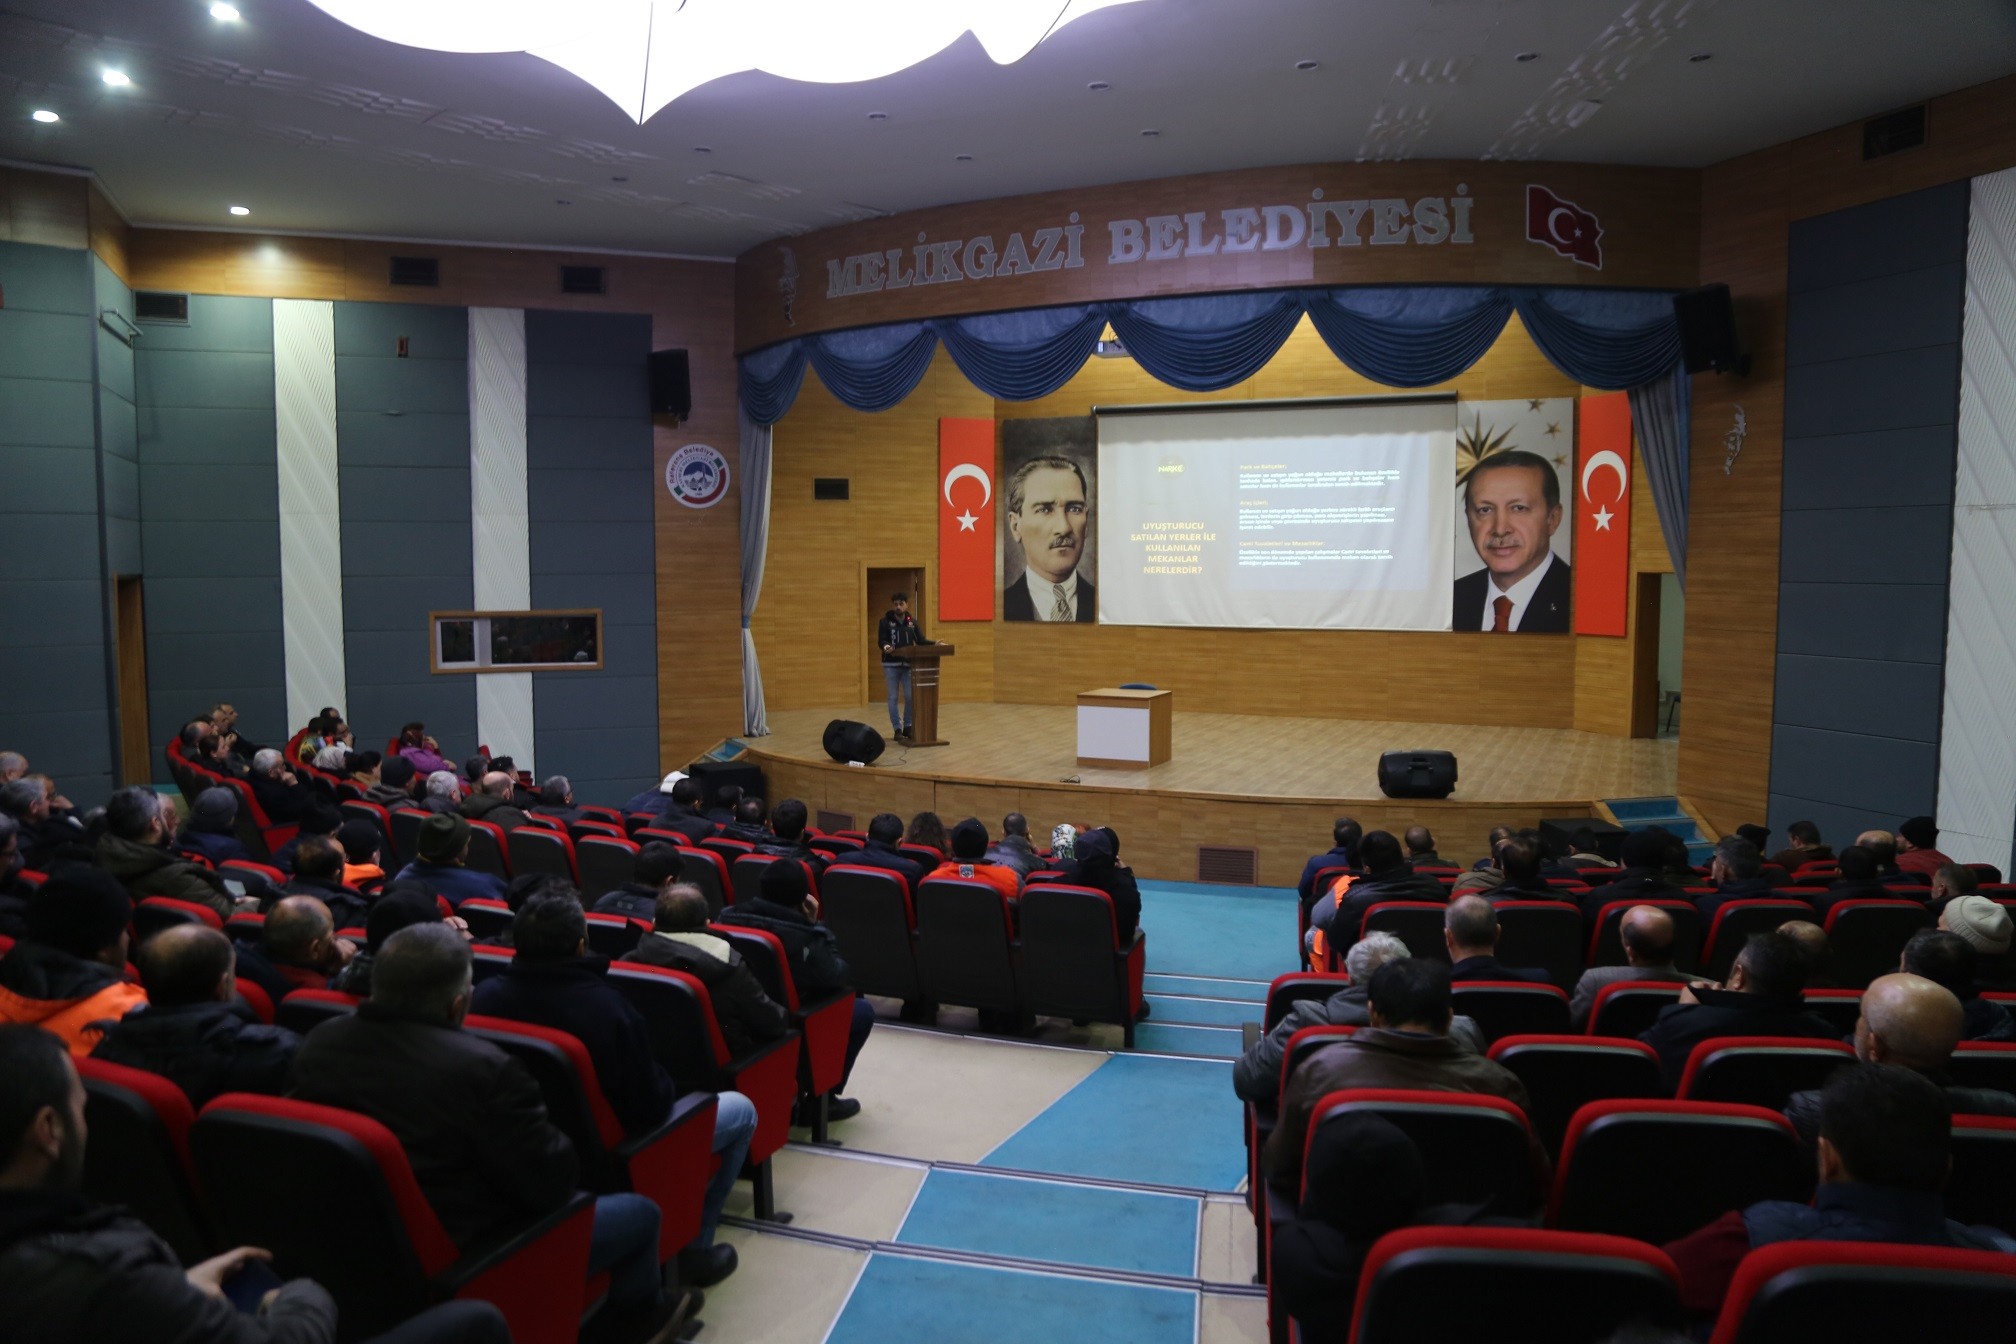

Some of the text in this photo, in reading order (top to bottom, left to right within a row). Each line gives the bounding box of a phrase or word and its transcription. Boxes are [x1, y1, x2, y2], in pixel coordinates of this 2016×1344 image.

[826, 183, 1474, 298] MELİKGAZİ BELEDİYESİ
[1143, 522, 1204, 531] UYUŞTURUCU
[1130, 532, 1217, 541] SATILAN YERLER İLE
[1145, 544, 1201, 552] KULLANILAN
[1148, 555, 1199, 563] MEKANLAR
[1143, 566, 1203, 574] NERELERDİR?
